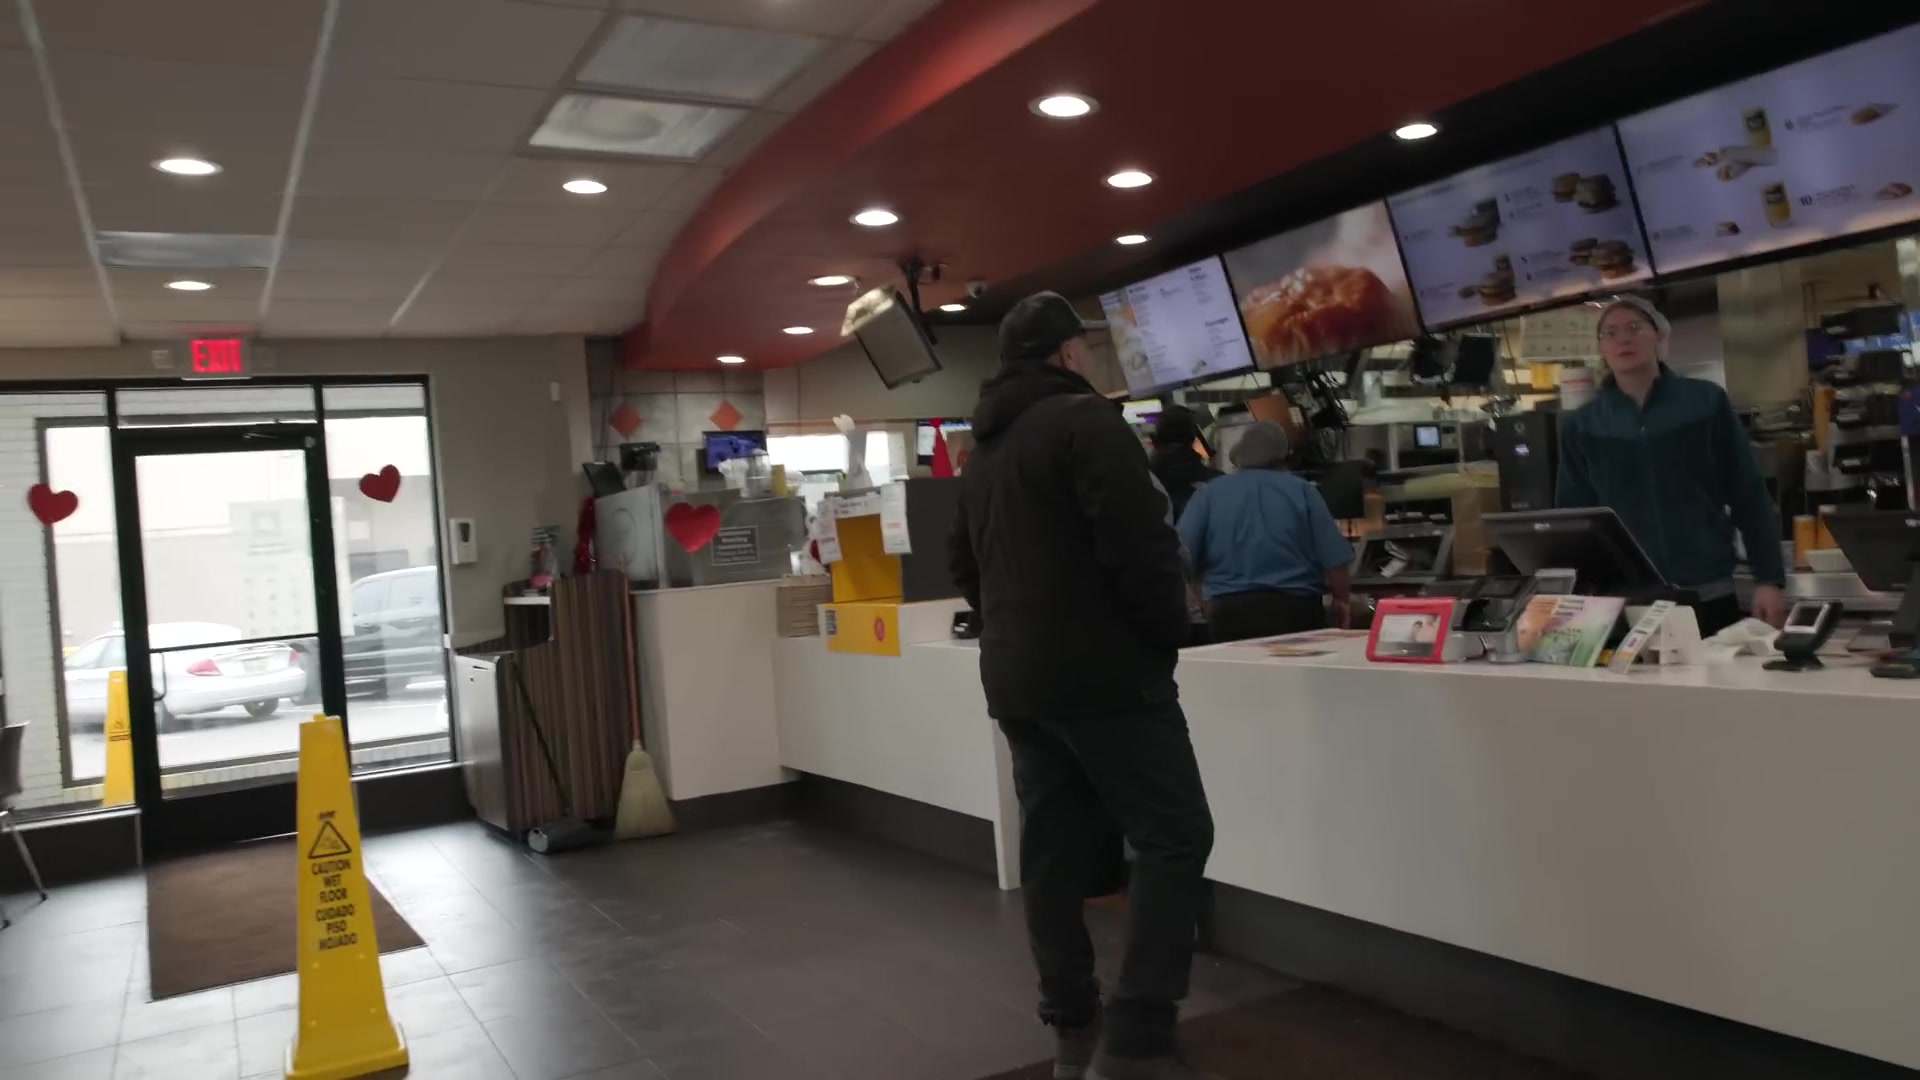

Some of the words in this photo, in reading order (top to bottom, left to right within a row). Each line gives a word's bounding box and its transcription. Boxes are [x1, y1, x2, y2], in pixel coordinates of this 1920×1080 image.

[190, 339, 243, 373] EXIT
[312, 859, 351, 875] CAUTION
[323, 874, 342, 887] WET
[319, 888, 348, 903] FLOOR
[315, 904, 355, 922] CUIDADO
[326, 920, 347, 935] PISO
[319, 933, 357, 951] MOJADO
